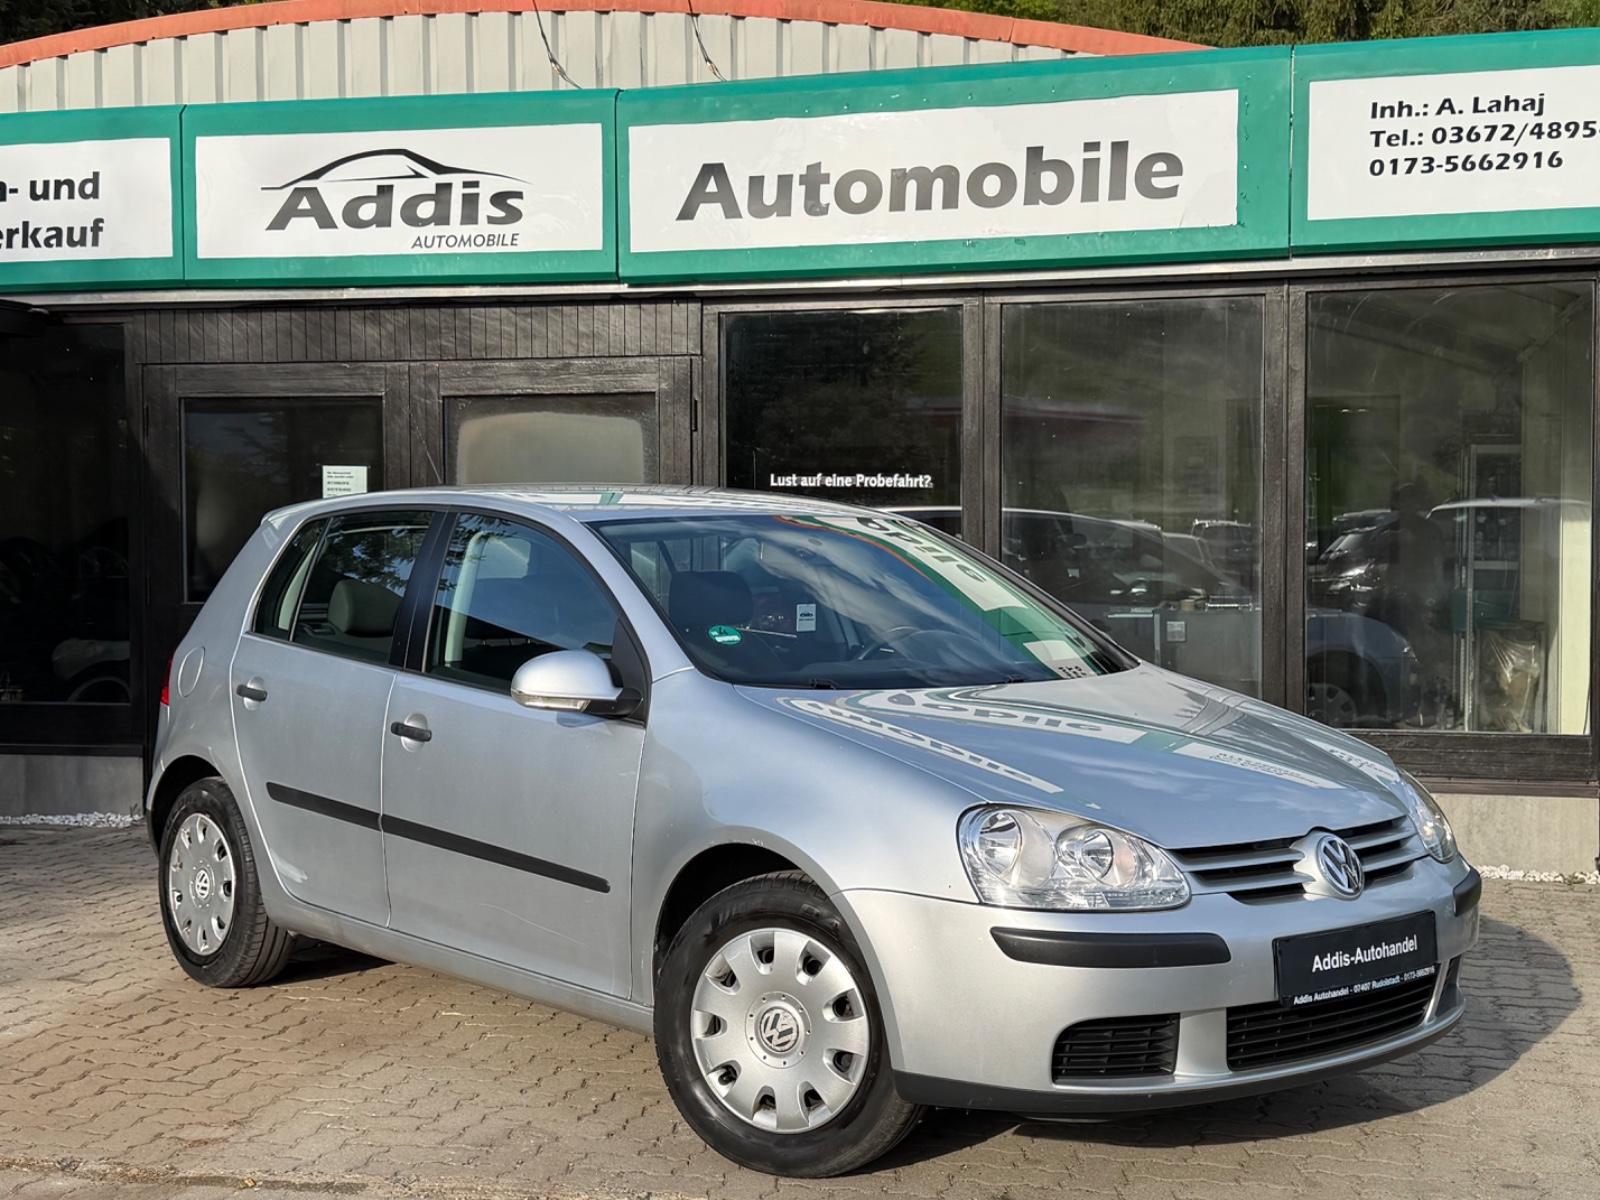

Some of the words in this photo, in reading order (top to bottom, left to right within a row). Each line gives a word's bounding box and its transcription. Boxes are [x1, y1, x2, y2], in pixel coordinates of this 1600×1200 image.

[1370, 101, 1429, 119] Inh.:
[1435, 98, 1464, 116] A.
[1472, 93, 1545, 116] Lahaj
[1370, 129, 1424, 148] Tel.:
[1431, 120, 1600, 147] 03672/4895
[1369, 151, 1563, 176] 0173-5662916
[29, 171, 100, 201] und
[675, 140, 1184, 221] Automobile
[265, 181, 524, 231] Addis
[0, 217, 105, 249] rkauf
[411, 232, 520, 249] AUTOMOBILE
[770, 473, 797, 488] Lust
[800, 472, 822, 488] auf
[825, 473, 852, 488] eine
[856, 473, 932, 489] Probefahrt?
[1311, 934, 1418, 973] Addis-Autohandel
[1313, 986, 1349, 1001] Autohandel
